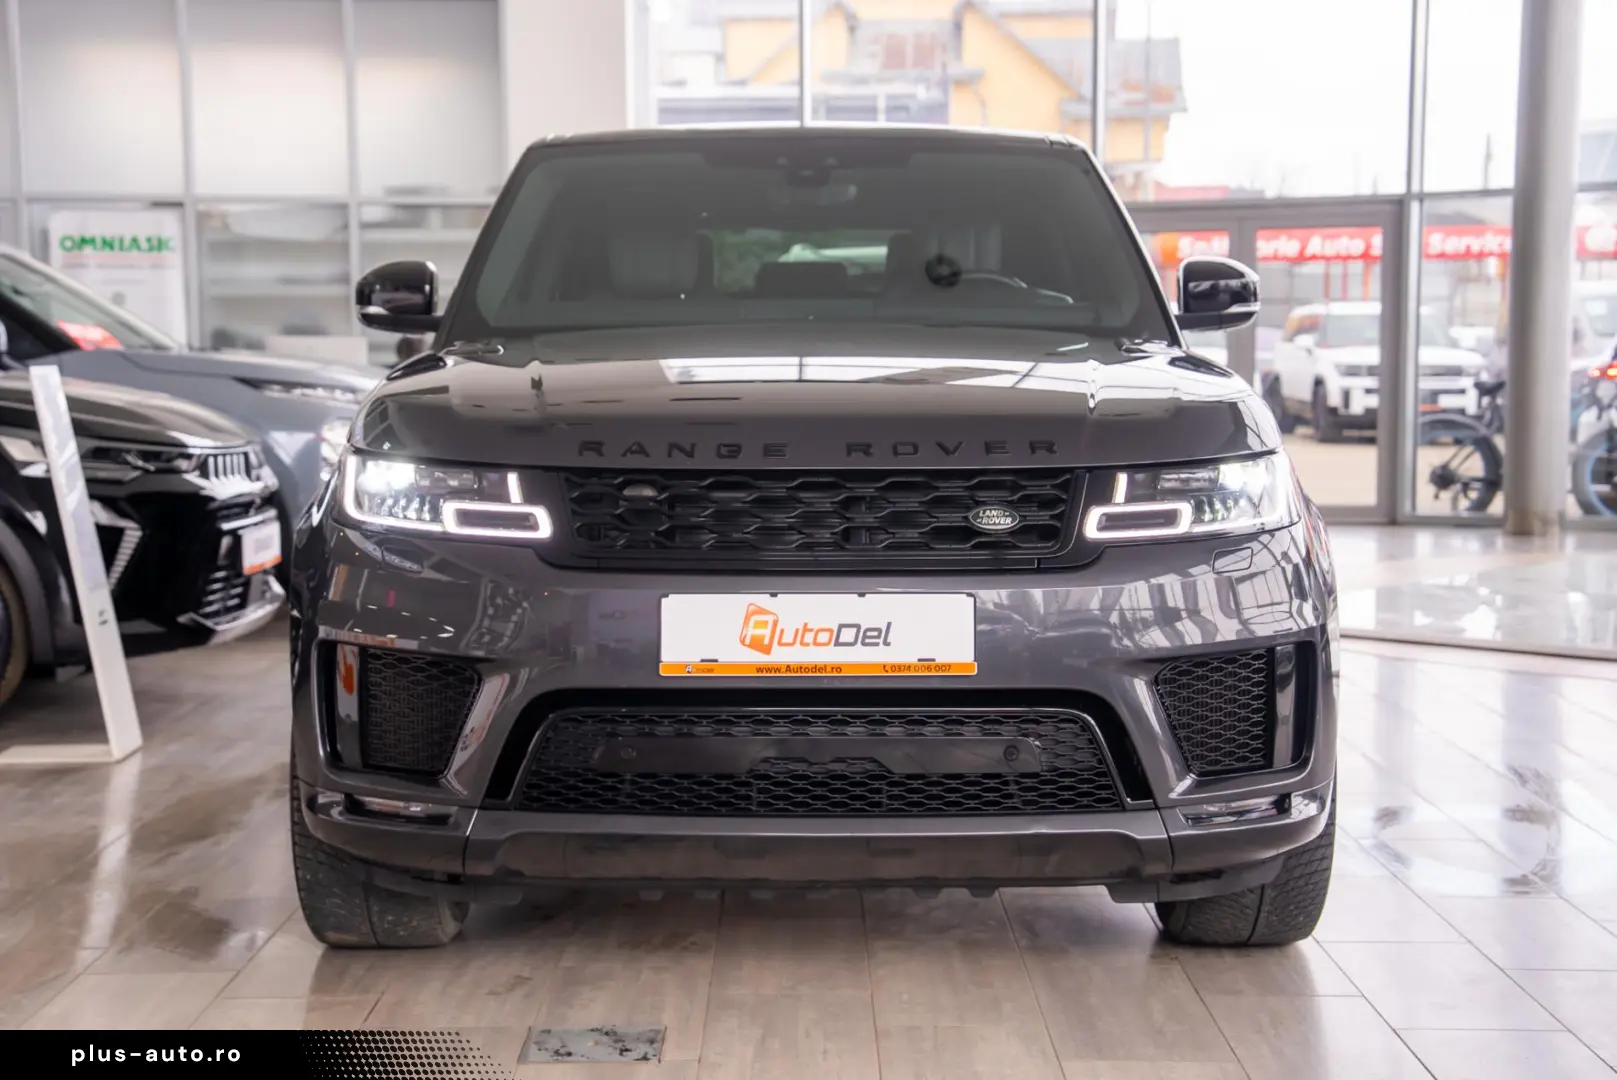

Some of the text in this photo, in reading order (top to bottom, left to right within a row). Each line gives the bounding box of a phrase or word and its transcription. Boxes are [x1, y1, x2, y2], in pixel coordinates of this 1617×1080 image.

[578, 440, 1058, 459] RANGE ROVER
[744, 611, 893, 648] AutoDel
[755, 664, 842, 674] www.Autodel.ro
[890, 664, 912, 673] 0374
